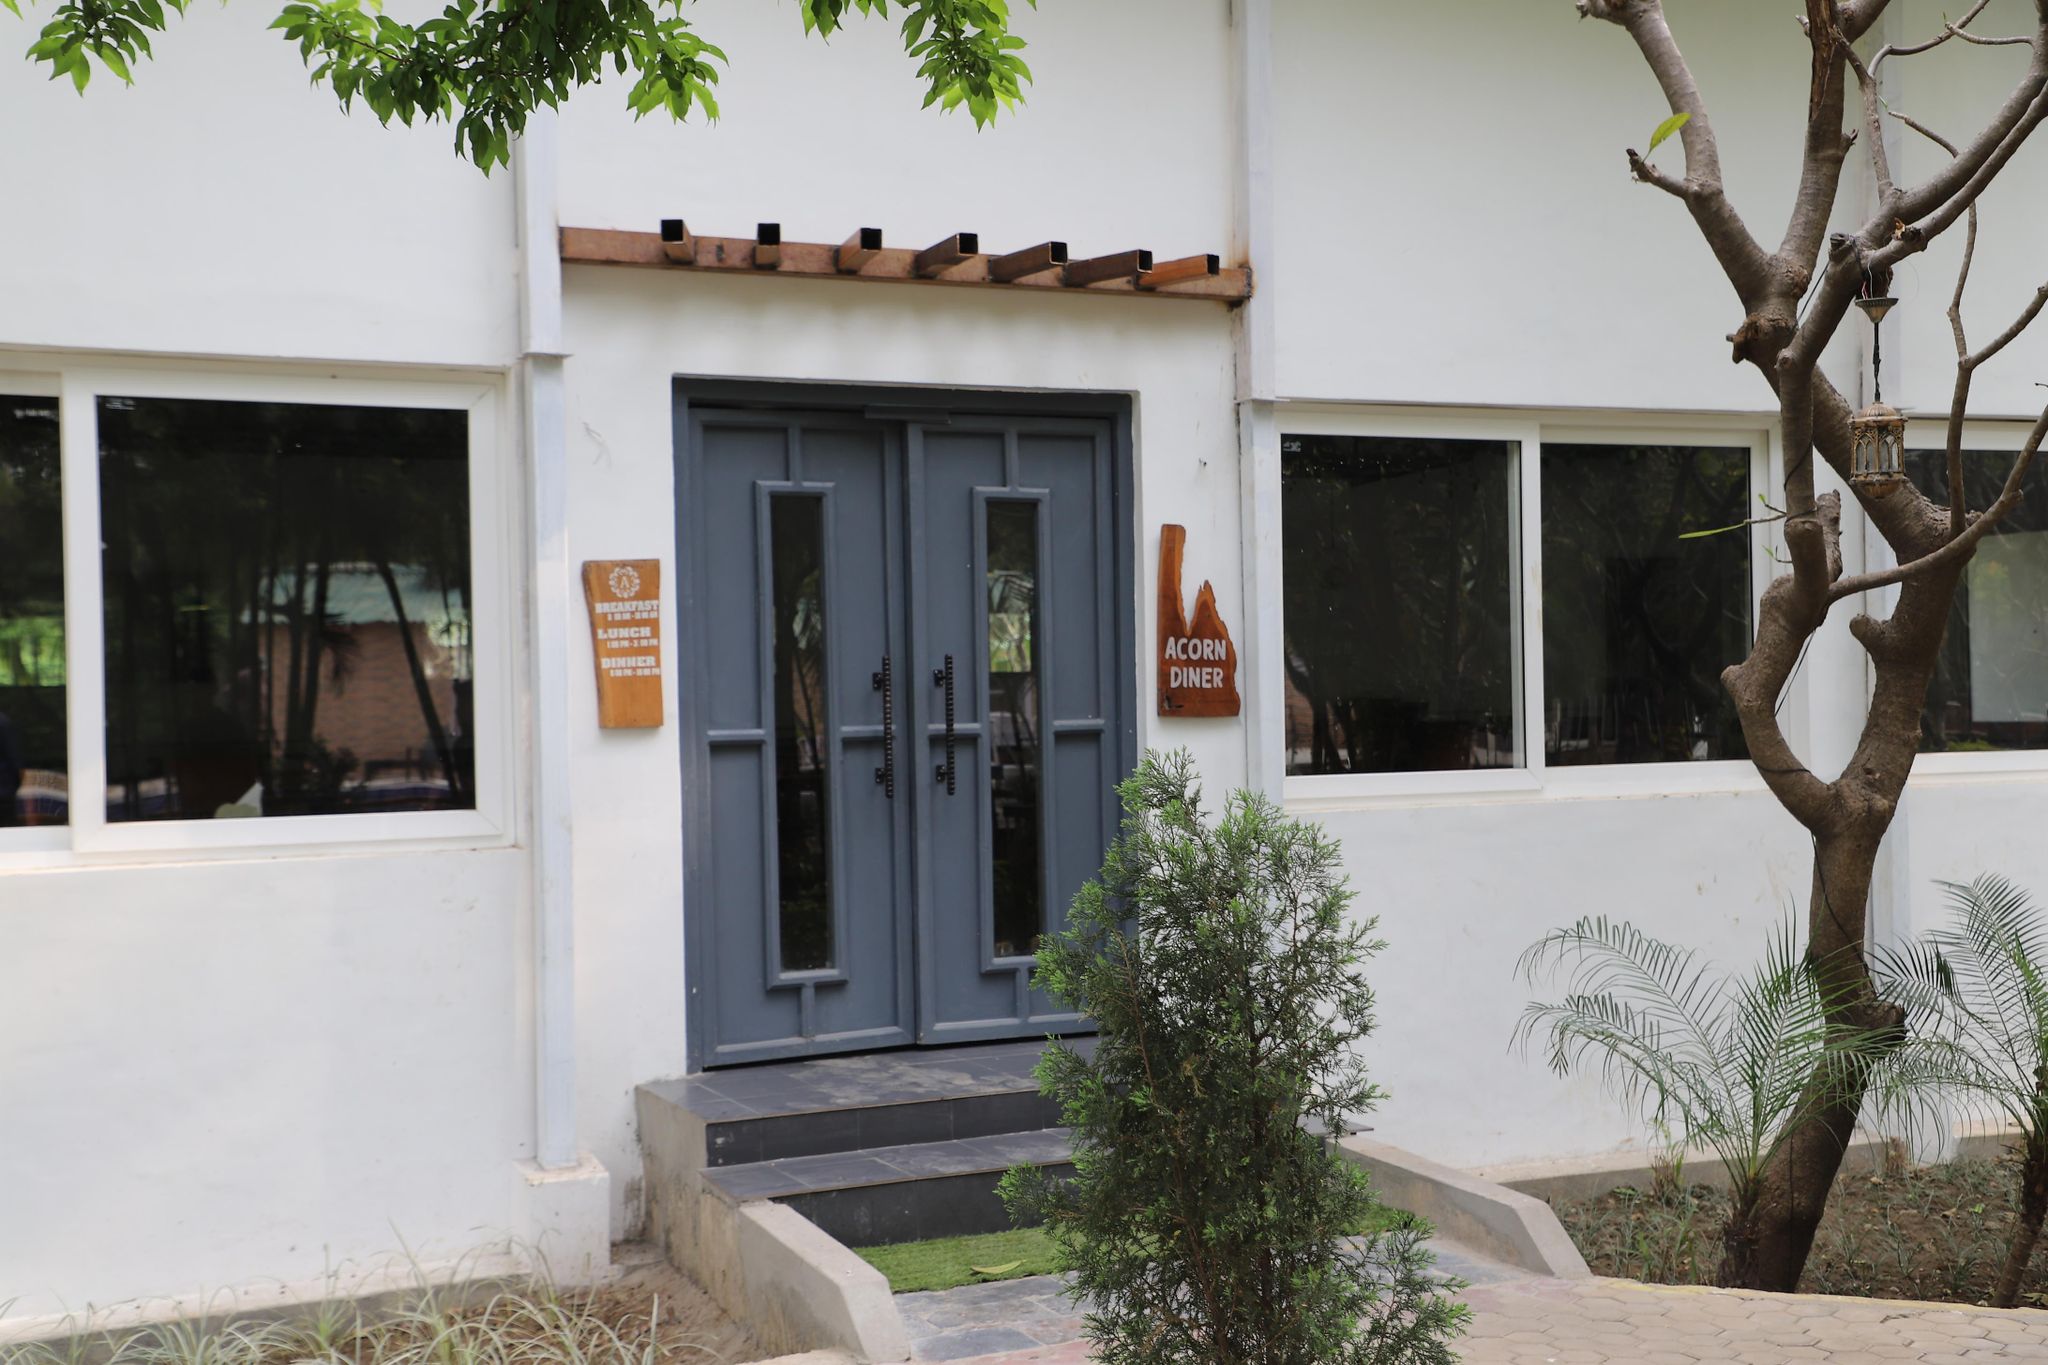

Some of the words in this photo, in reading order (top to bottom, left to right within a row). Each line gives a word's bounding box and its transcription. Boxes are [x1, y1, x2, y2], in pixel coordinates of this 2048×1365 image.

[595, 600, 660, 614] BREAKFAST
[597, 627, 651, 640] LUNCH
[1165, 636, 1227, 660] ACORN
[601, 656, 656, 669] DINNER
[1170, 666, 1224, 688] DINER
